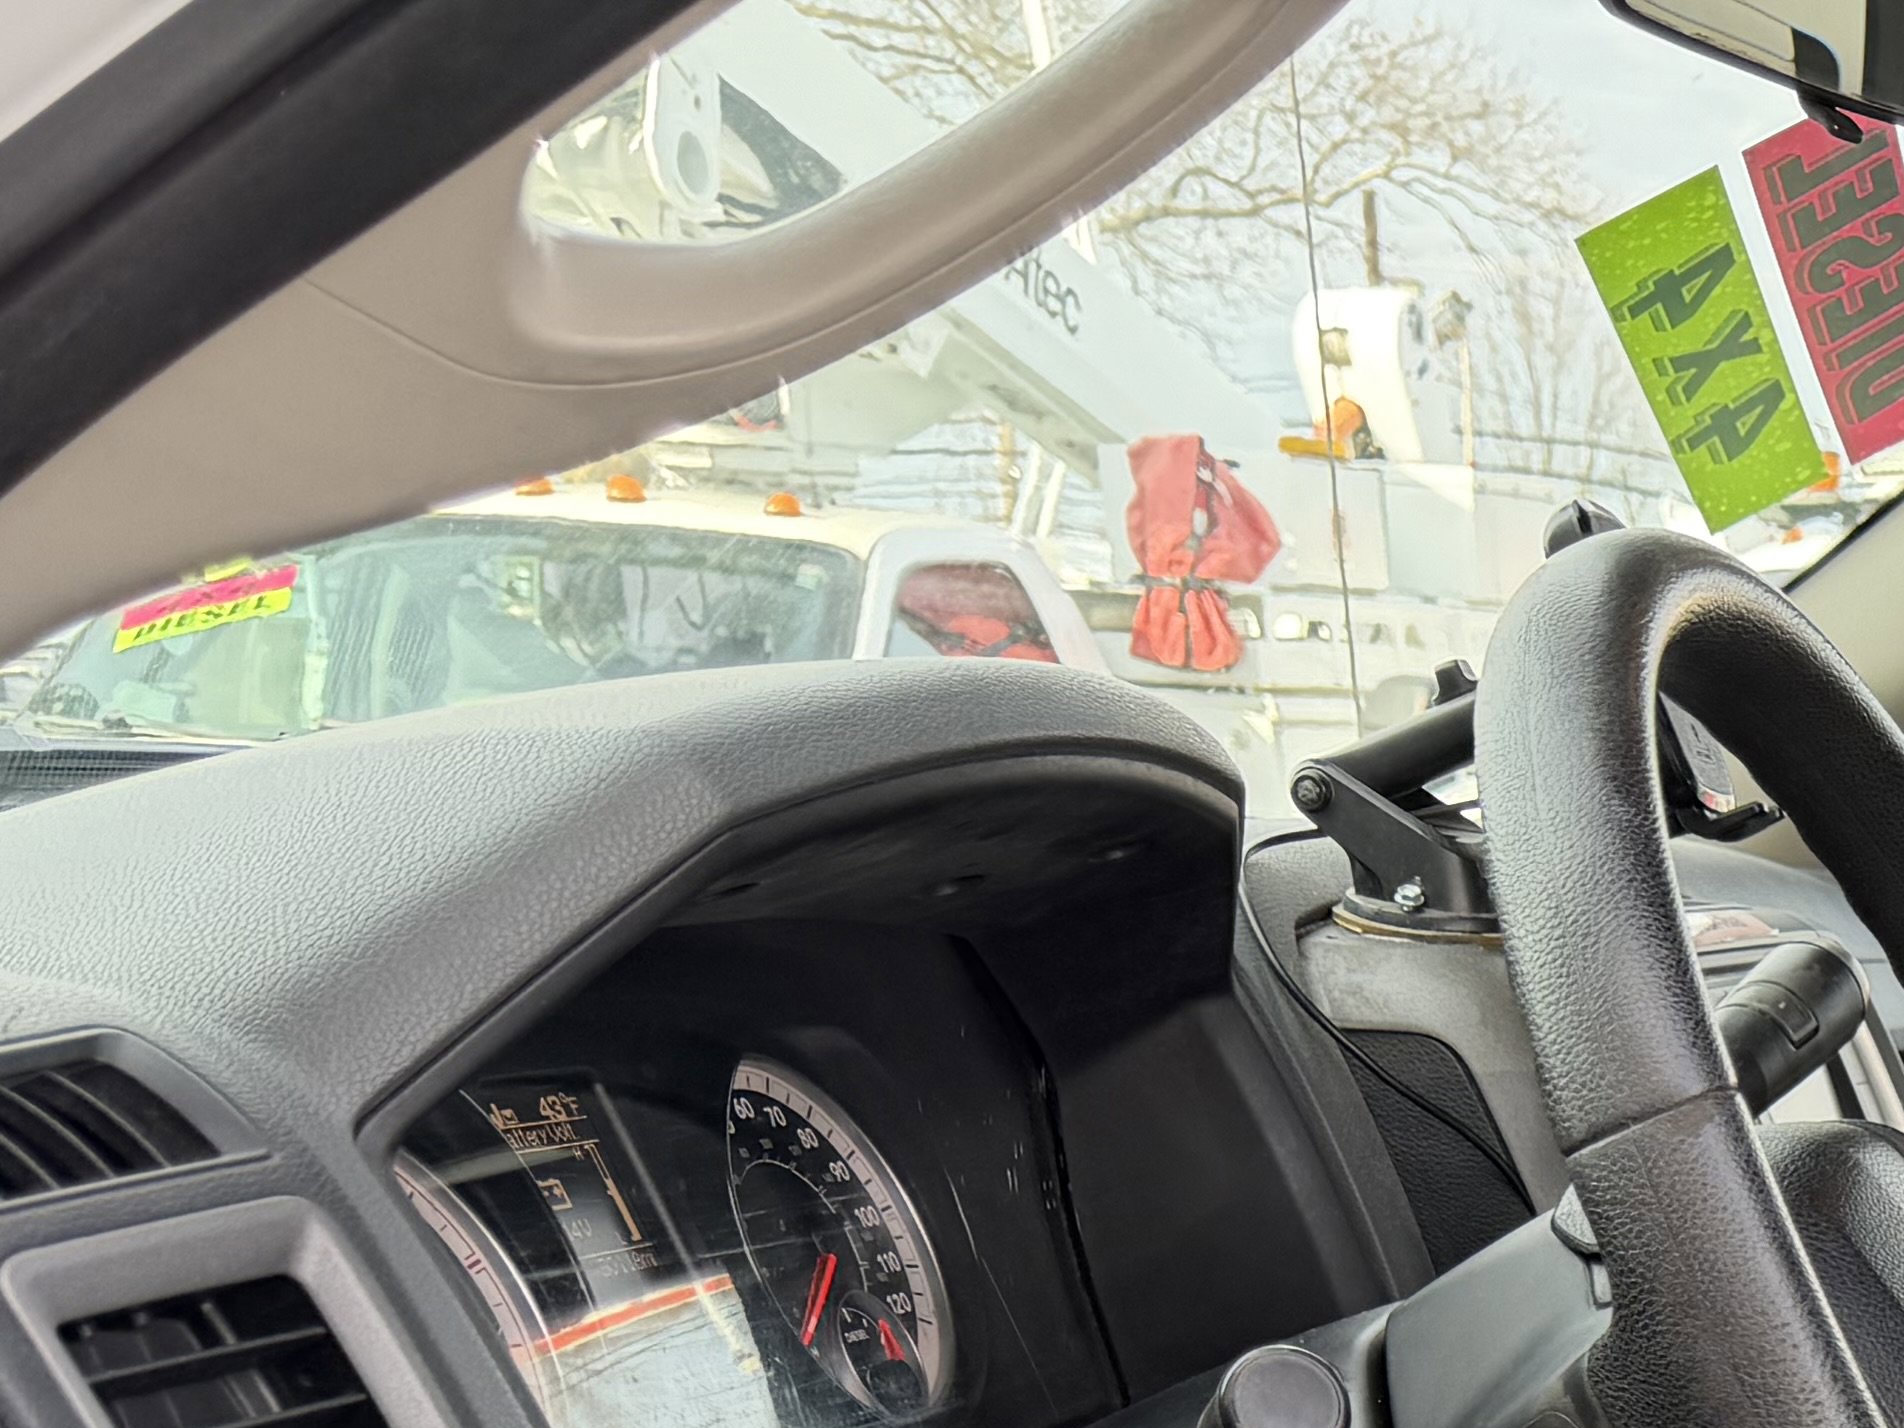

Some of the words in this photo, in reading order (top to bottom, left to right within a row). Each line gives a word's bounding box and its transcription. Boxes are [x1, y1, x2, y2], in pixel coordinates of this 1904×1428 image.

[733, 1097, 756, 1119] 60
[763, 1106, 787, 1128] 70
[506, 1126, 548, 1150] attery
[797, 1128, 819, 1149] 80
[829, 1160, 851, 1183] 90
[854, 1205, 881, 1228] 100
[876, 1251, 902, 1274] 110
[886, 1292, 913, 1315] 120
